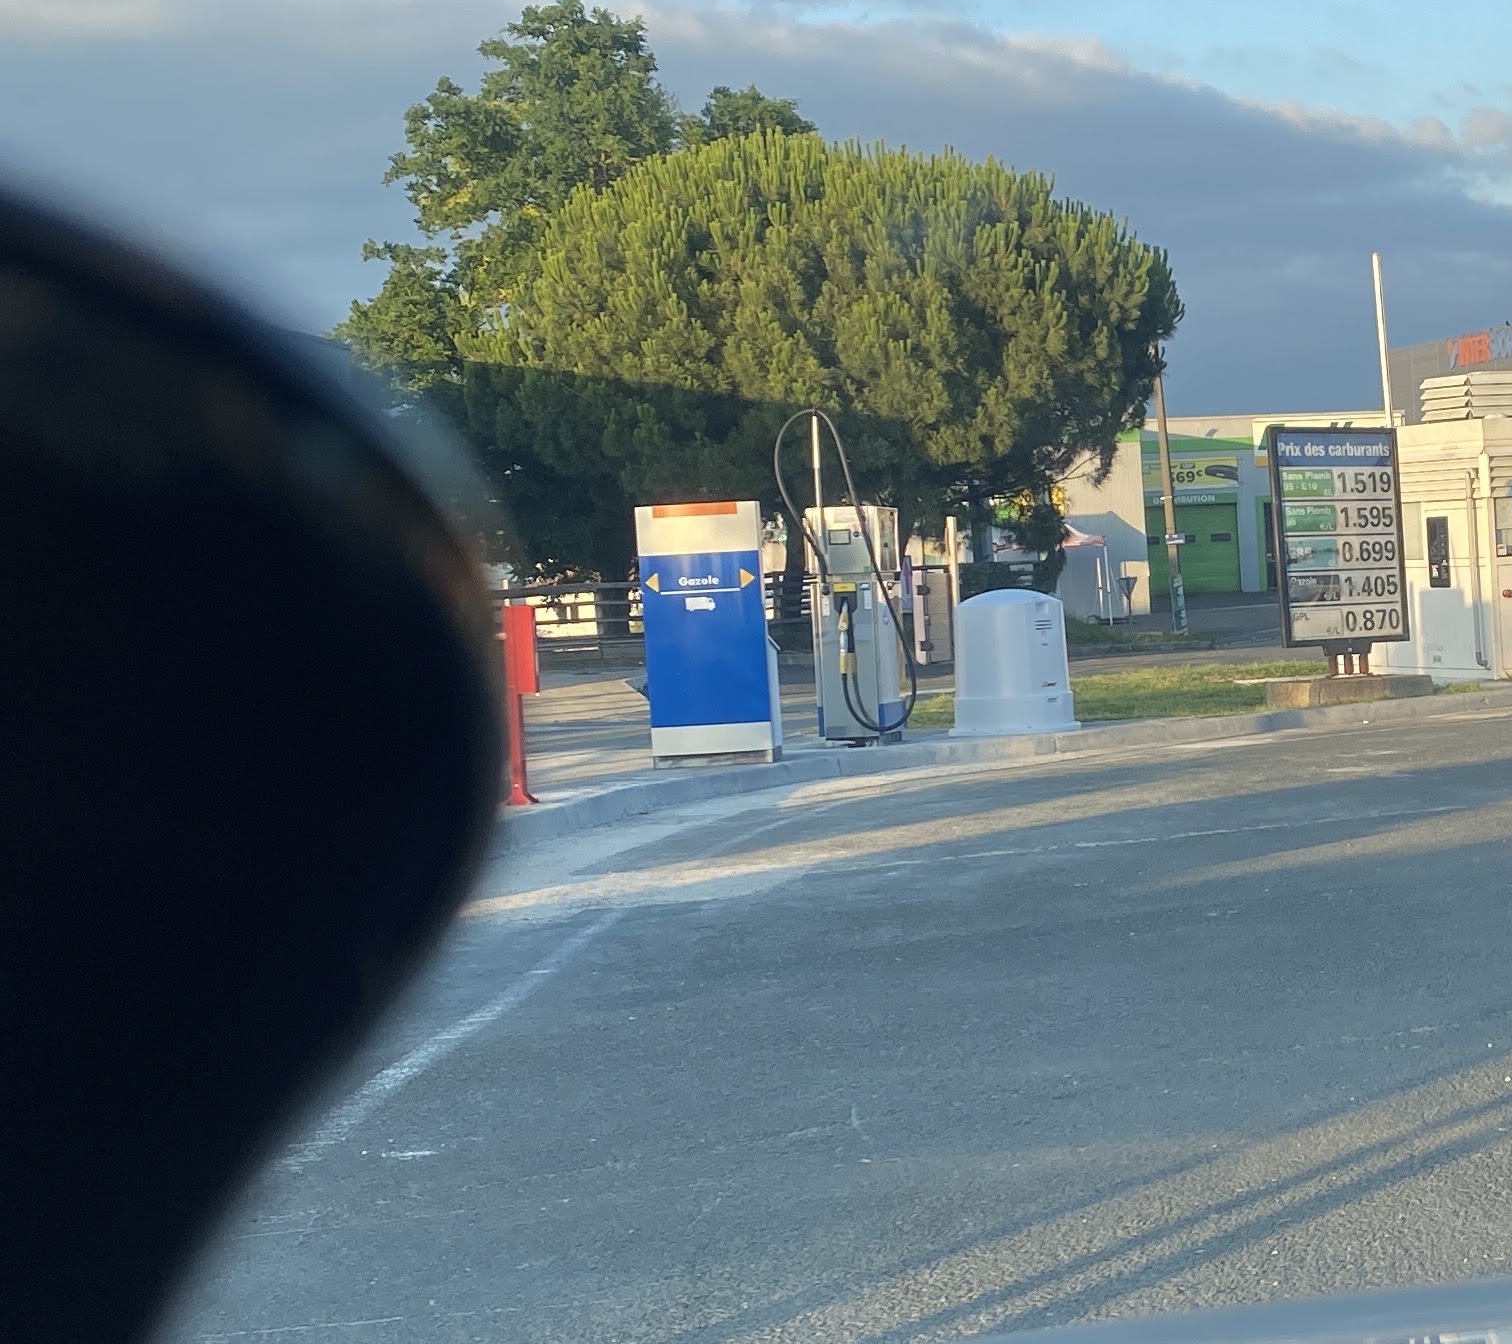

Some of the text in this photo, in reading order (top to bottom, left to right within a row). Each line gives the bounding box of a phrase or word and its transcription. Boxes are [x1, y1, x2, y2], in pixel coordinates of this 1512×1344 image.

[1278, 441, 1390, 457] Prix des carburants
[1337, 471, 1391, 494] 1.519
[1285, 506, 1305, 516] Sans
[1340, 506, 1393, 528] 1.595
[1342, 540, 1395, 563] 0.699
[678, 574, 720, 587] Gazole
[1345, 574, 1398, 597] 1.405
[1345, 608, 1400, 632] 0.870
